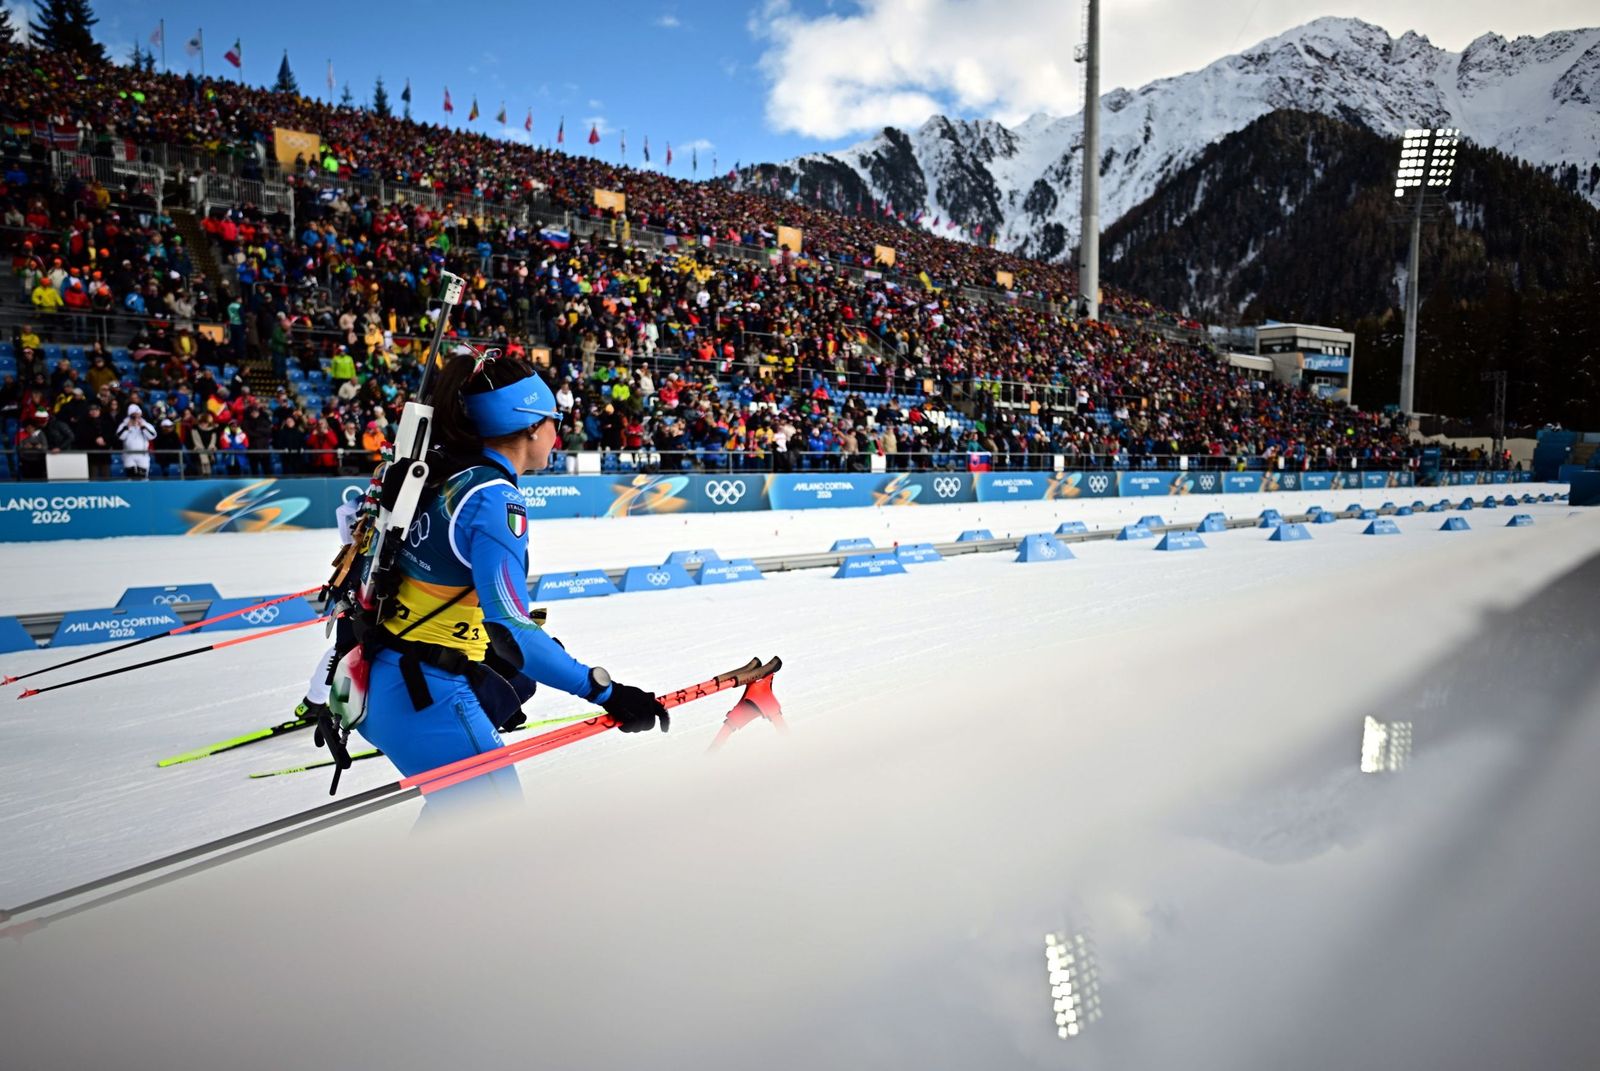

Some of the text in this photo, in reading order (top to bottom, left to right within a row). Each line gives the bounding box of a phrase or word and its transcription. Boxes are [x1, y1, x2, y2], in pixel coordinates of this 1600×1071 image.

[534, 486, 581, 497] CORTINA
[793, 482, 824, 491] MILANO
[51, 495, 131, 510] CORTINA
[525, 497, 547, 507] 2026
[32, 510, 72, 524] 2026
[542, 577, 608, 590] MILANO CORTINA
[64, 615, 175, 633] MILANO CORTINA
[109, 628, 135, 638] 2026
